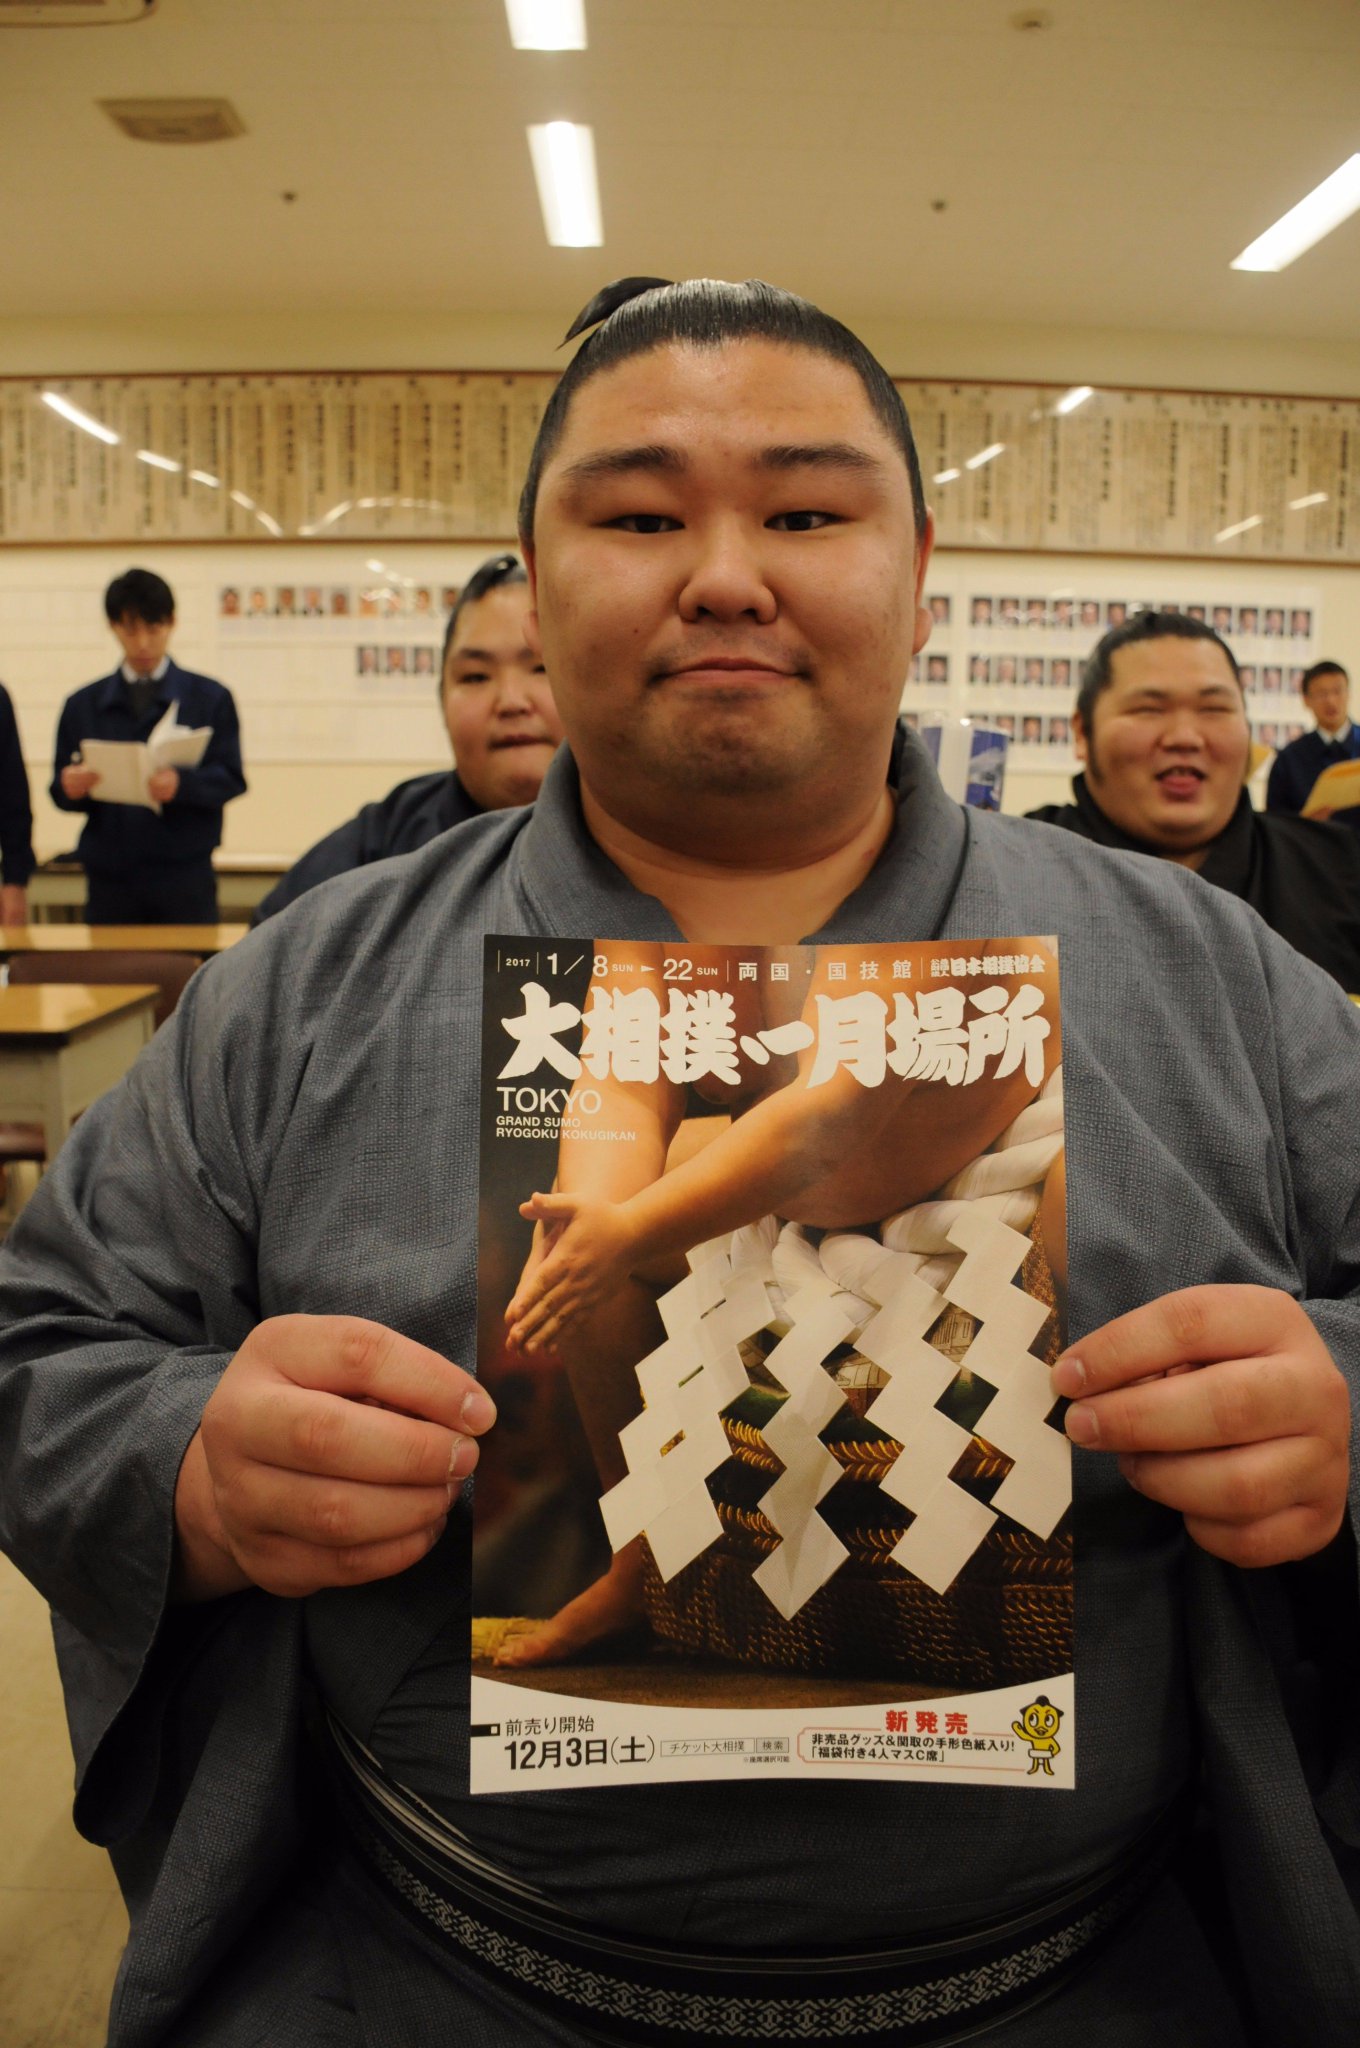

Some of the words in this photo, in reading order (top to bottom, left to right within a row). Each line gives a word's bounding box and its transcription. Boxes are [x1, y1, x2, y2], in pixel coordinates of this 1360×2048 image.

[506, 957, 531, 968] 2017
[612, 963, 633, 973] SUN
[663, 958, 693, 981] 22
[696, 966, 718, 976] SUN
[496, 1086, 602, 1115] TOKYO
[496, 1115, 541, 1127] GRAND
[543, 1117, 581, 1128] SUMO
[496, 1127, 558, 1140] RYOGOKU
[561, 1129, 636, 1141] KOKUGIKAN
[505, 1714, 595, 1736] 前売り開始
[885, 1709, 969, 1735] 新発売
[504, 1734, 656, 1770] 12月3日(土)
[668, 1740, 746, 1754] チケット大相撲
[761, 1740, 784, 1752] 検索
